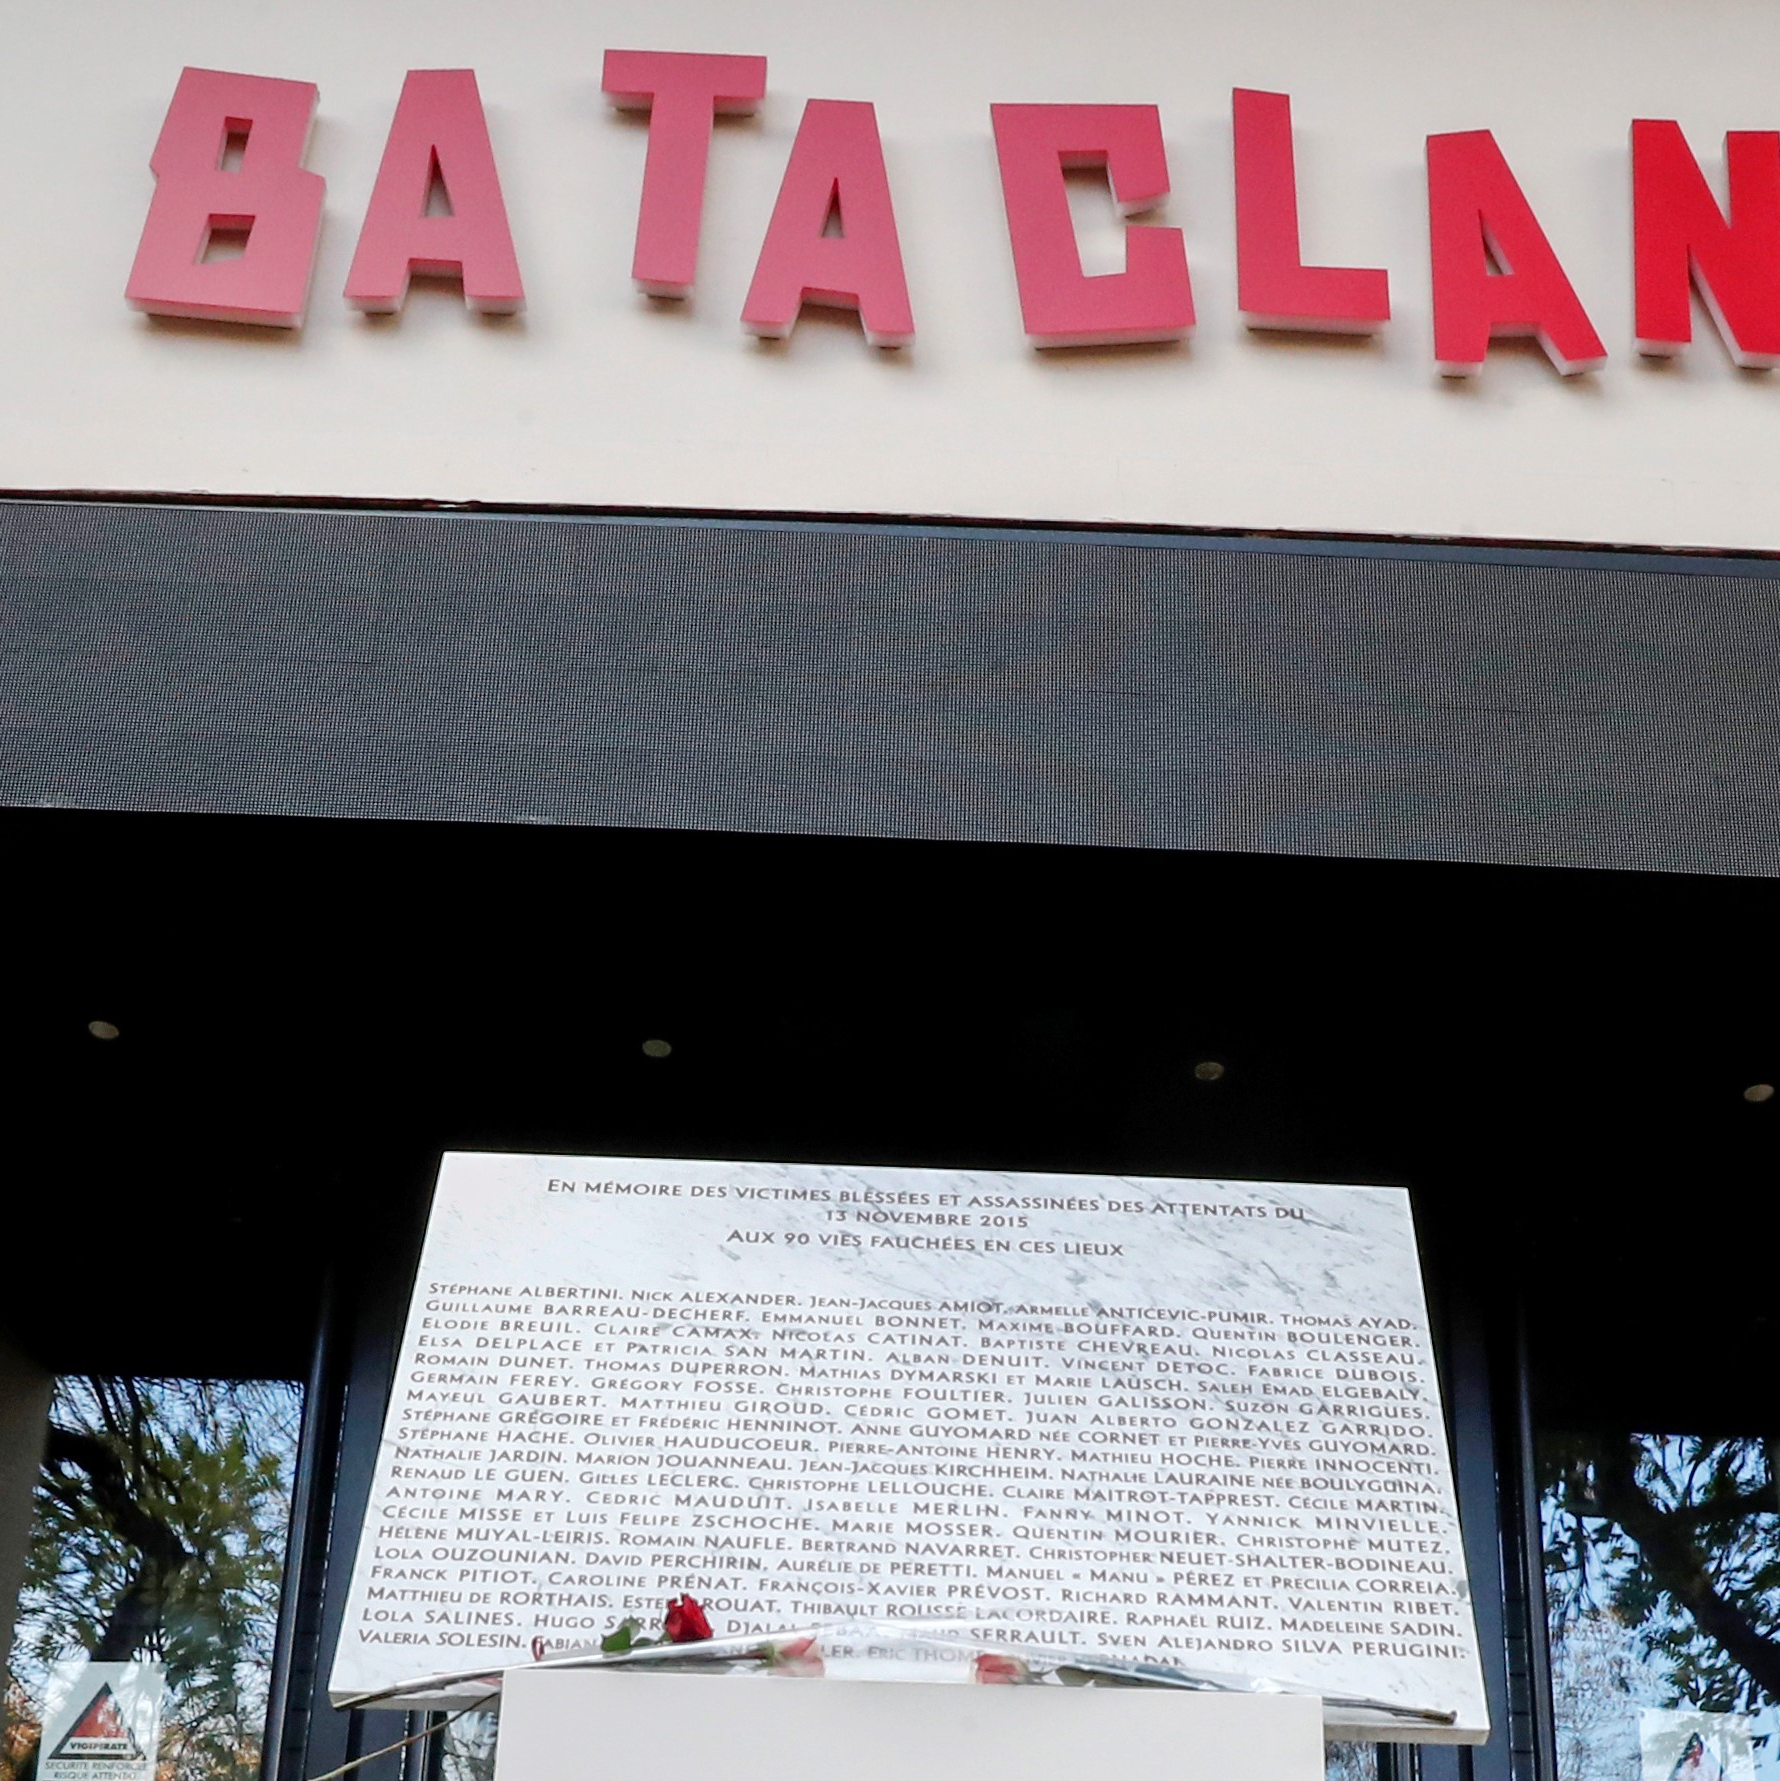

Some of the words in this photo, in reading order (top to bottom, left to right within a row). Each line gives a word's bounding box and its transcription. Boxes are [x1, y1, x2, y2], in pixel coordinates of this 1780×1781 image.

[782, 1231, 810, 1245] 90
[825, 1209, 847, 1222] 13
[979, 1214, 1028, 1228] 2015
[518, 1285, 624, 1300] ALBERTINI.
[678, 1290, 803, 1306] ALEXANDER.
[1356, 1316, 1417, 1330] AYAD.
[542, 1303, 750, 1322] BARREAU-DECHERF.
[874, 1314, 966, 1330] BONNET.
[1062, 1321, 1181, 1338] BOUFFARD.
[1286, 1330, 1420, 1347] BOULENGER.
[498, 1319, 582, 1334] BREUIL.
[866, 1331, 967, 1347] CATINAT.
[1076, 1339, 1200, 1357] CHEVREAU.
[497, 1354, 574, 1369] DUNET.
[669, 1360, 789, 1377] DUPERRON.
[889, 1368, 996, 1384] DYMARSKI
[1321, 1383, 1428, 1401] ELGEBALY.
[509, 1373, 580, 1388] FEREY.
[692, 1379, 764, 1394] FOSSE.
[902, 1387, 1012, 1403] FOULTIER.
[1097, 1394, 1214, 1412] GALISSON.
[1297, 1402, 1430, 1420] GARRIGUES.
[496, 1391, 608, 1408] GAUBERT.
[733, 1399, 831, 1416] GIROUD.
[926, 1406, 1012, 1422] GOMET.
[1188, 1415, 1310, 1433] GONZALEZ
[1320, 1421, 1433, 1438] GARRIDO.
[496, 1429, 576, 1444] HACHE.
[663, 1434, 819, 1453] HAUDUCOEUR.
[985, 1445, 1062, 1461] HENRY.
[1160, 1451, 1241, 1468] HOCHE.
[1314, 1457, 1439, 1475] INNOCENTI.
[472, 1467, 497, 1481] LE
[502, 1467, 570, 1483] GUEN.
[646, 1472, 740, 1489] LECLERC.
[867, 1479, 993, 1497] LELLOUCHE.
[1355, 1497, 1445, 1514] MARTIN.
[495, 1487, 571, 1503] MARY.
[673, 1492, 792, 1510] MAUDUIT.
[1105, 1508, 1191, 1524] MINOT.
[1314, 1515, 1447, 1534] MINVIELLE.
[703, 1534, 793, 1552] NAUFLE.
[904, 1541, 1020, 1558] NAVARRET.
[457, 1568, 538, 1584] PITIOT.
[656, 1572, 748, 1591] PRÉNAT.
[946, 1583, 1050, 1601] PRÉVOST.
[1155, 1591, 1278, 1609] RAMMANT.
[1392, 1599, 1459, 1616] RIBET.
[70, 1742, 128, 1750] VIGIPIRATE
[54, 1771, 89, 1780] RISQUE
